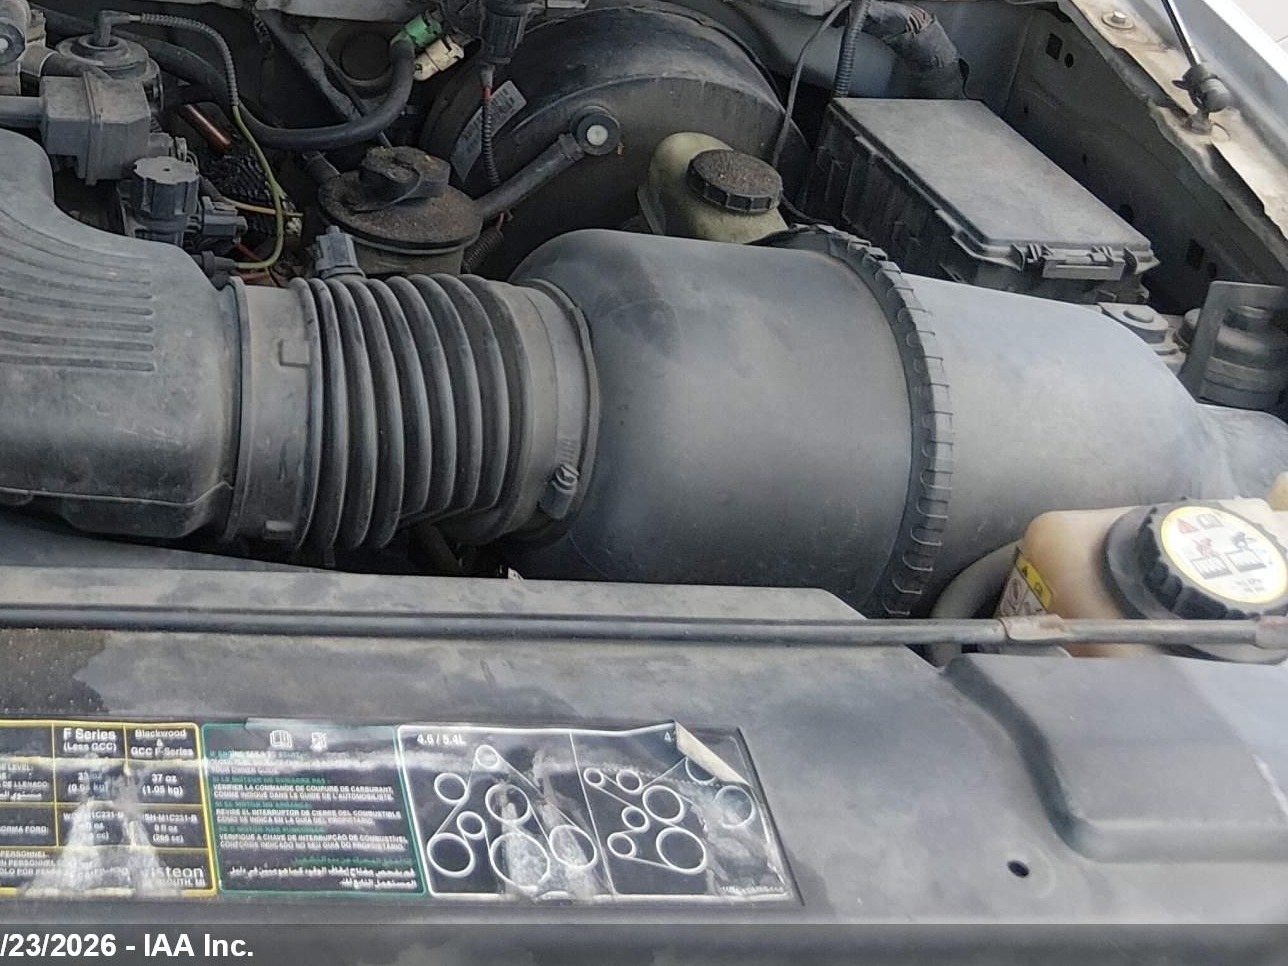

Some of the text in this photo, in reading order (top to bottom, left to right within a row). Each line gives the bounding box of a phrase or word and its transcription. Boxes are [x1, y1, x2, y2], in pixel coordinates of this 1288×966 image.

[63, 727, 116, 740] F Series
[134, 728, 187, 739] Blackwood
[416, 733, 435, 745] 4.6
[63, 741, 117, 753] (Less GCC)
[130, 747, 194, 757] GCC F-Series
[151, 772, 177, 783] 37 oz
[2, 780, 13, 788] DE
[167, 784, 184, 797] kg)
